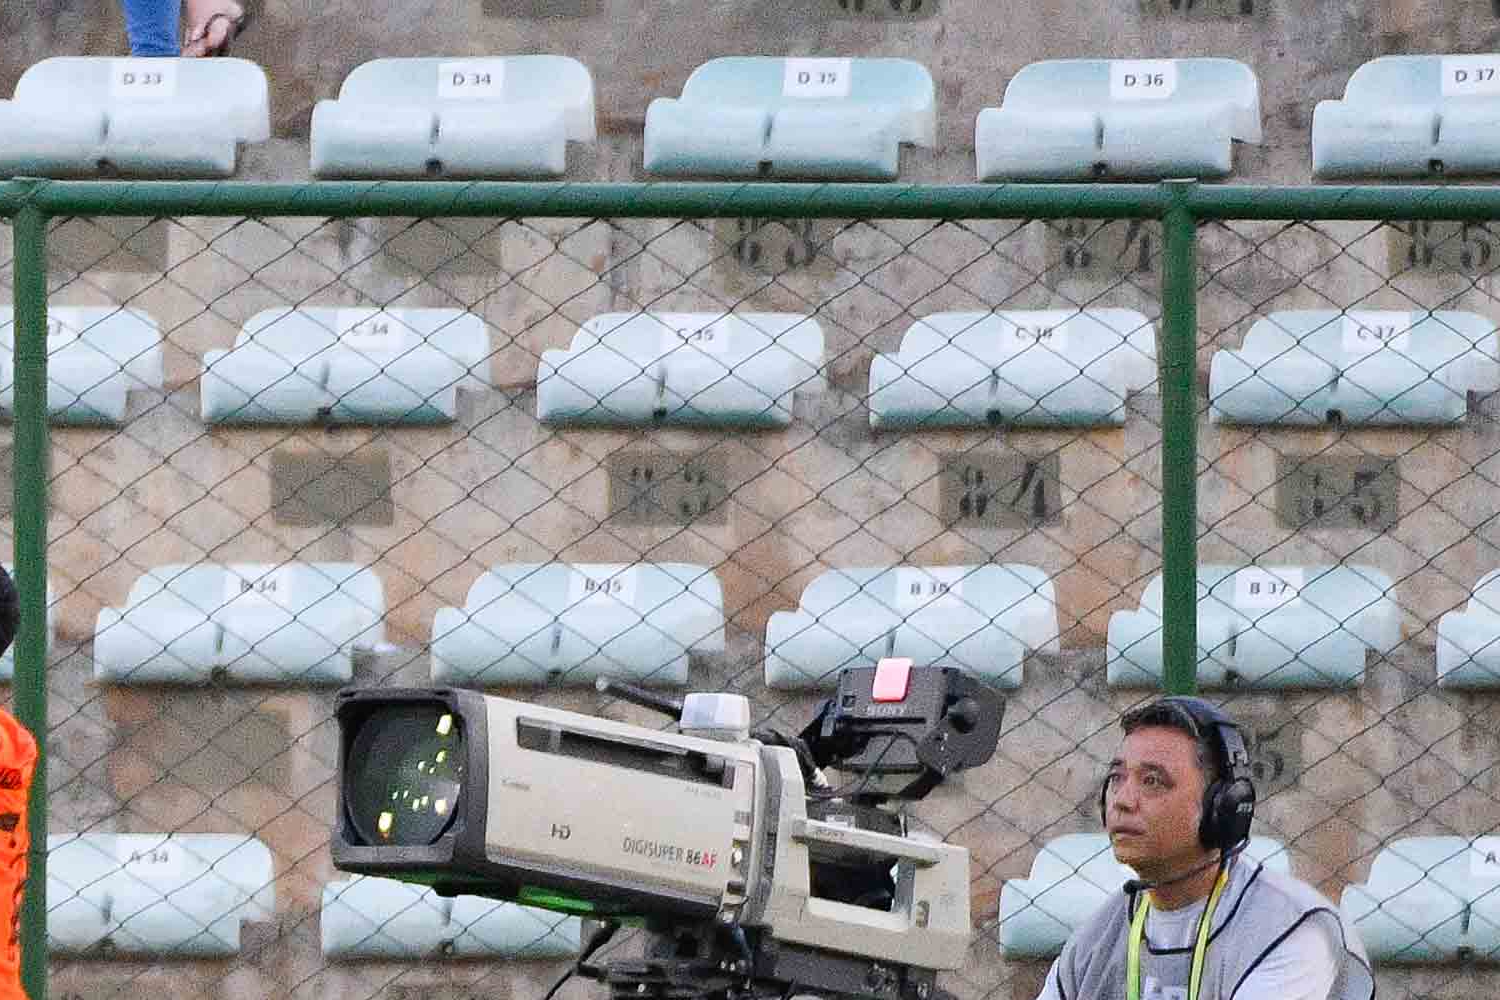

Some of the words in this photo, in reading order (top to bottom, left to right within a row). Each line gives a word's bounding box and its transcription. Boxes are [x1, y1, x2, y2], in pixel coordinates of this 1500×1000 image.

[122, 72, 136, 86] D
[452, 72, 466, 86] D
[796, 71, 811, 85] D
[1123, 73, 1137, 88] D
[1143, 73, 1164, 88] 36
[1454, 69, 1469, 83] D
[1475, 68, 1495, 82] 37
[551, 823, 572, 842] HD
[622, 837, 684, 863] DIGISUPER
